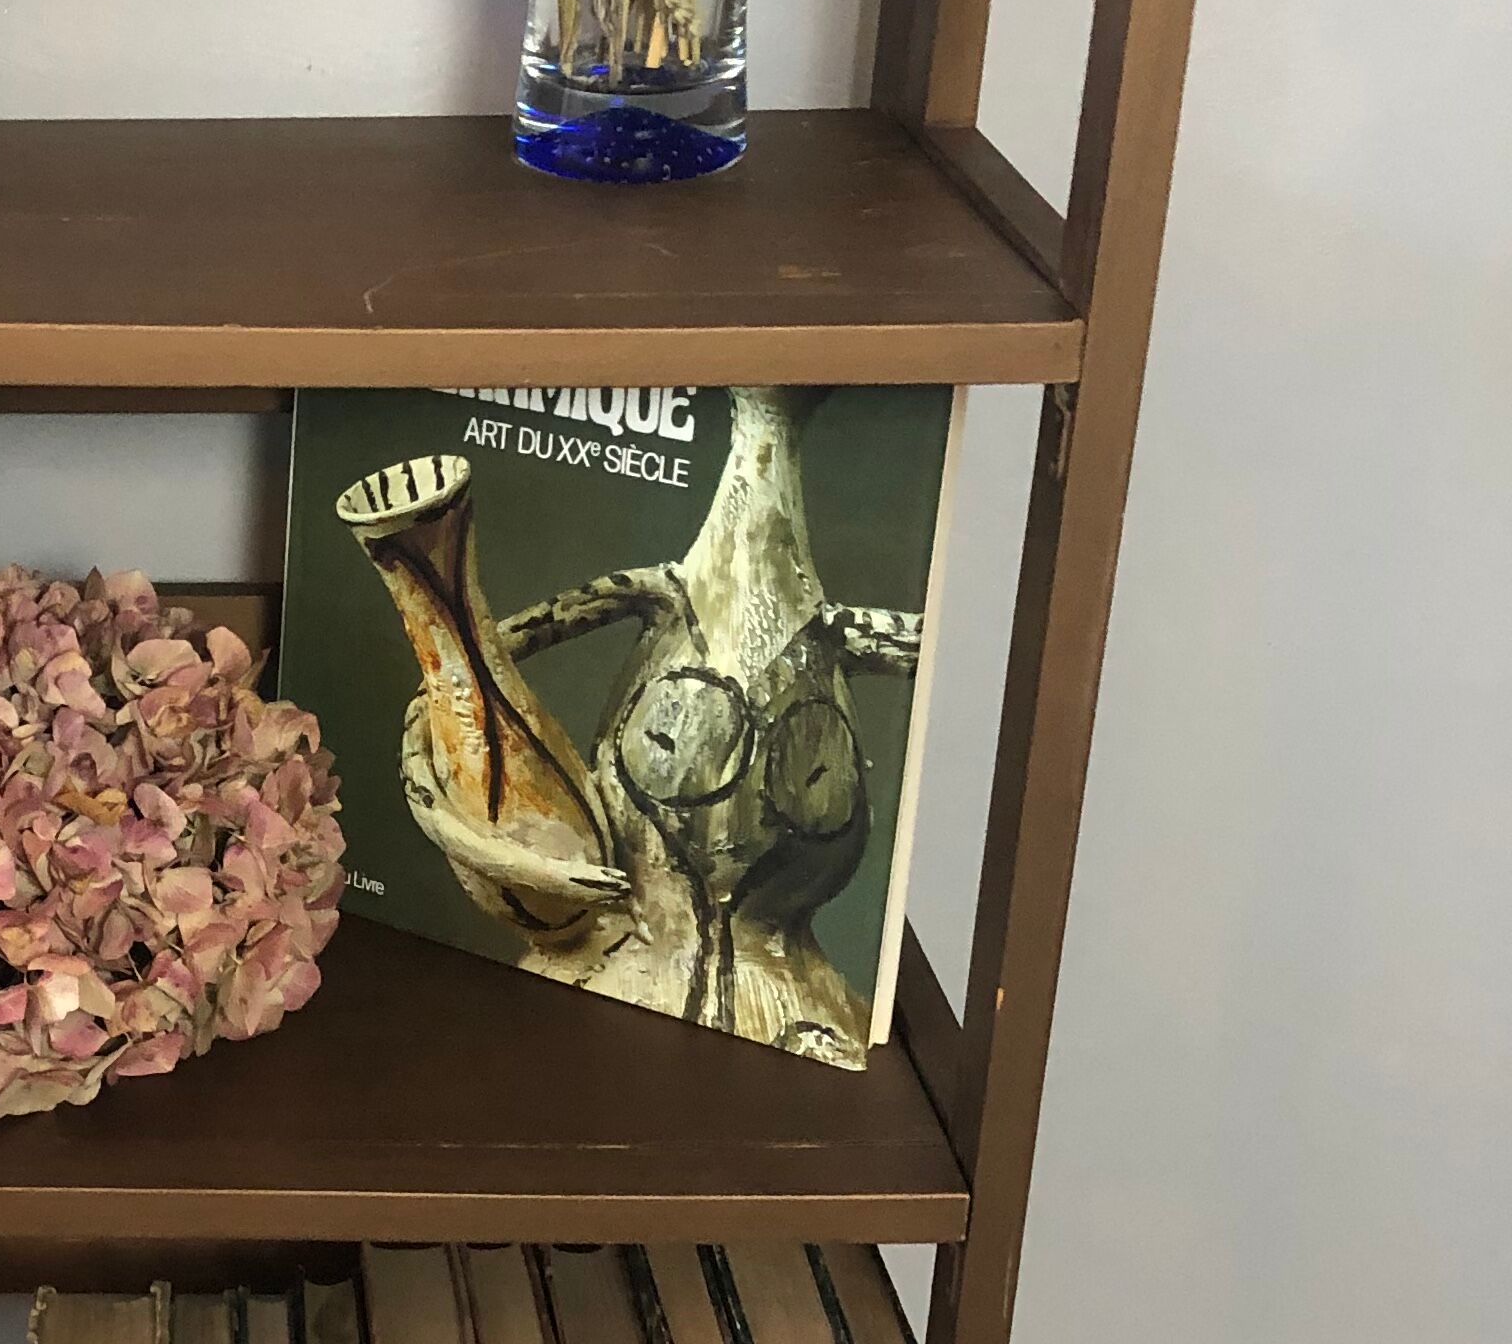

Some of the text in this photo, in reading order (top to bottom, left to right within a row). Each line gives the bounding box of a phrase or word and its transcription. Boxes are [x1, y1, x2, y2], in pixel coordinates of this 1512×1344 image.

[463, 417, 691, 488] ART DU XXe SIÈCLE
[353, 870, 385, 896] Livre
